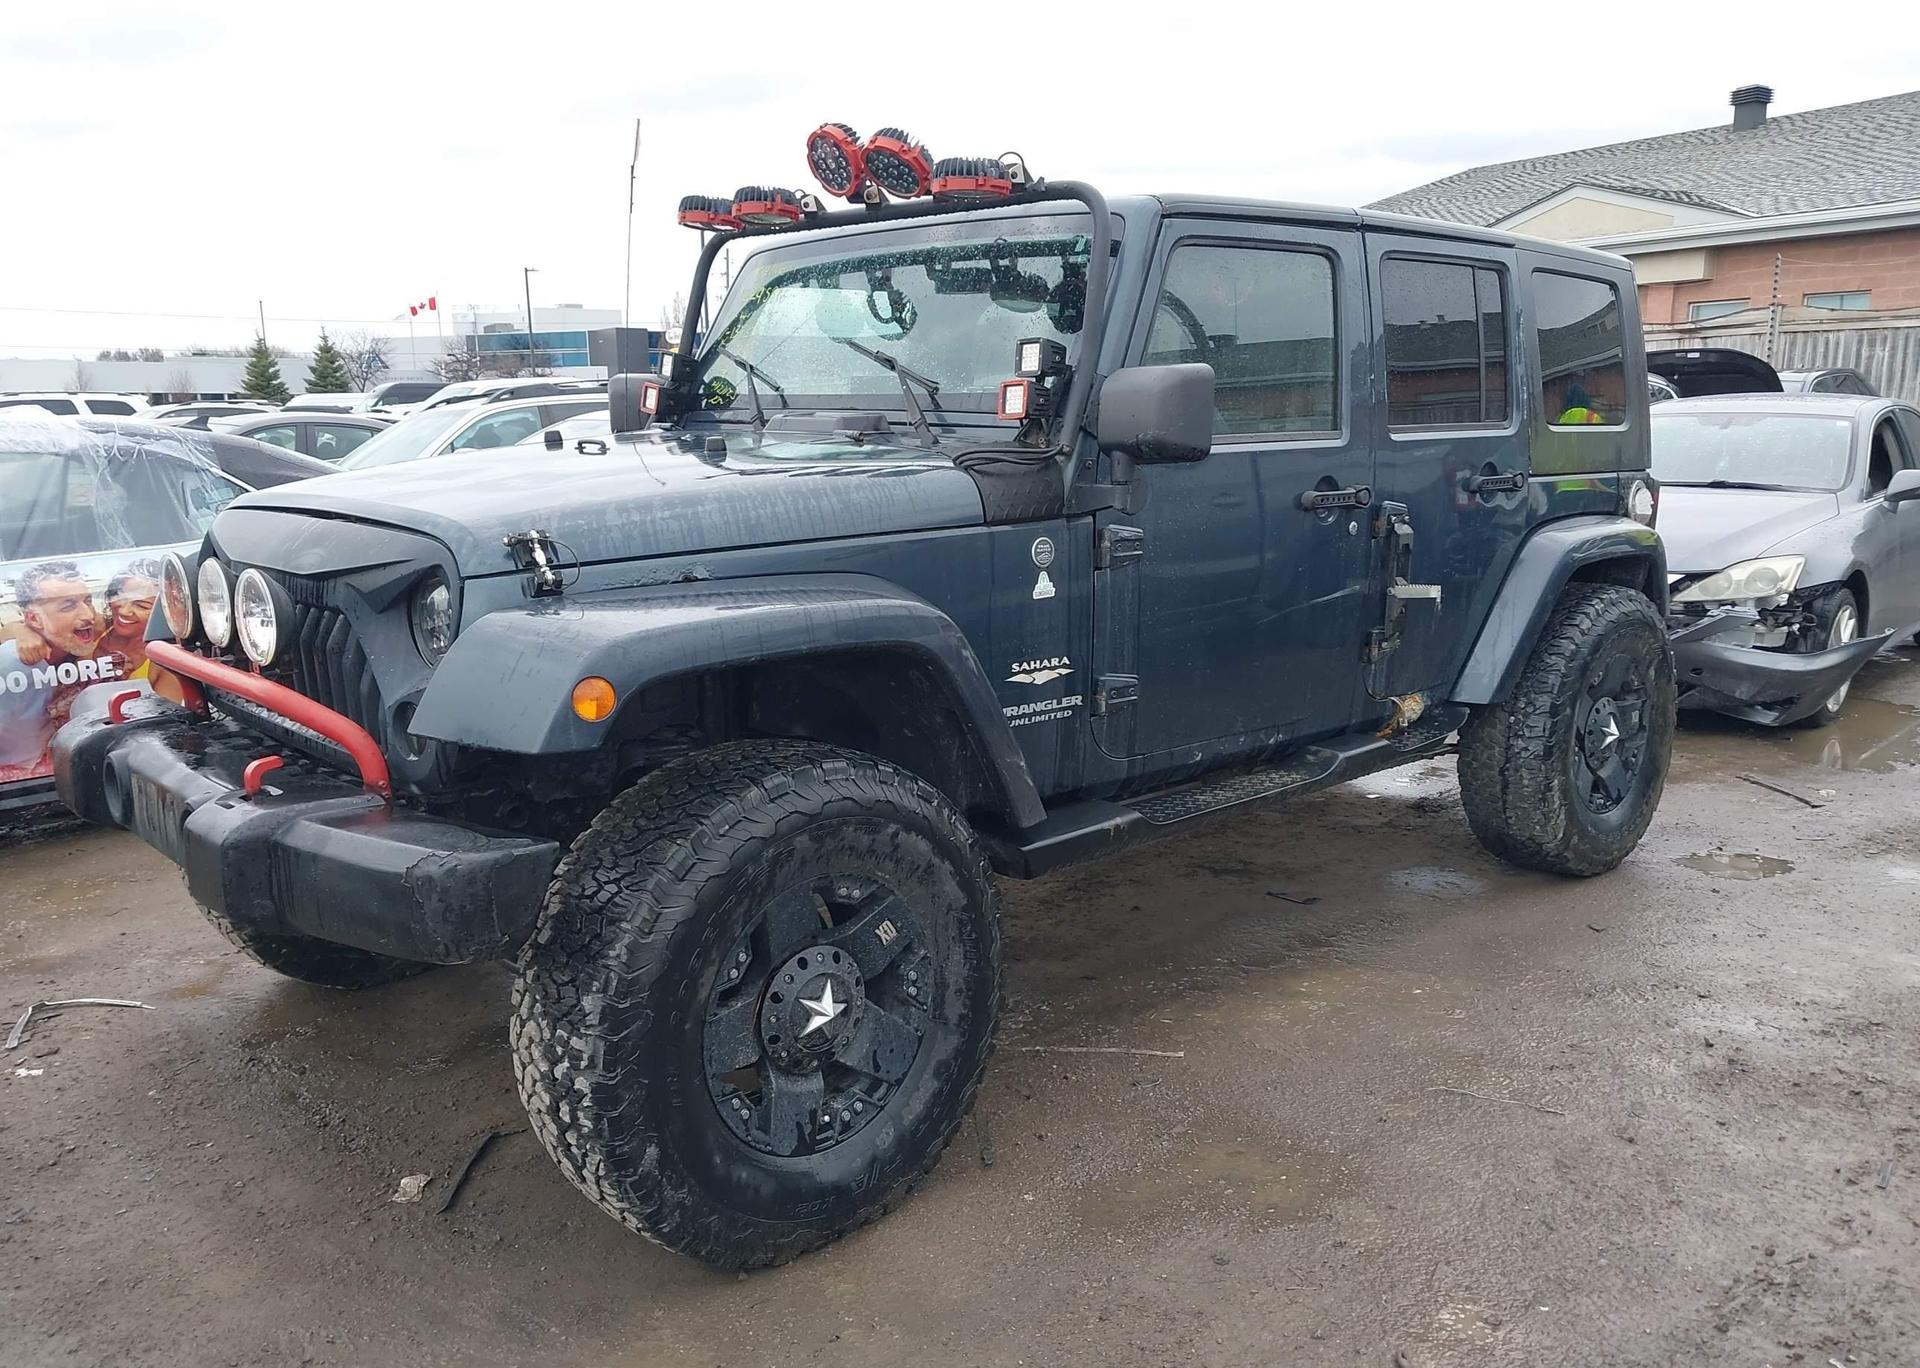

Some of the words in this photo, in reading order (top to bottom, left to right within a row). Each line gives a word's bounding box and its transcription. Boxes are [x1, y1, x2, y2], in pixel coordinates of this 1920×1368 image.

[0, 670, 28, 695] O
[32, 656, 124, 689] MORE.
[1011, 656, 1070, 672] SAHARA
